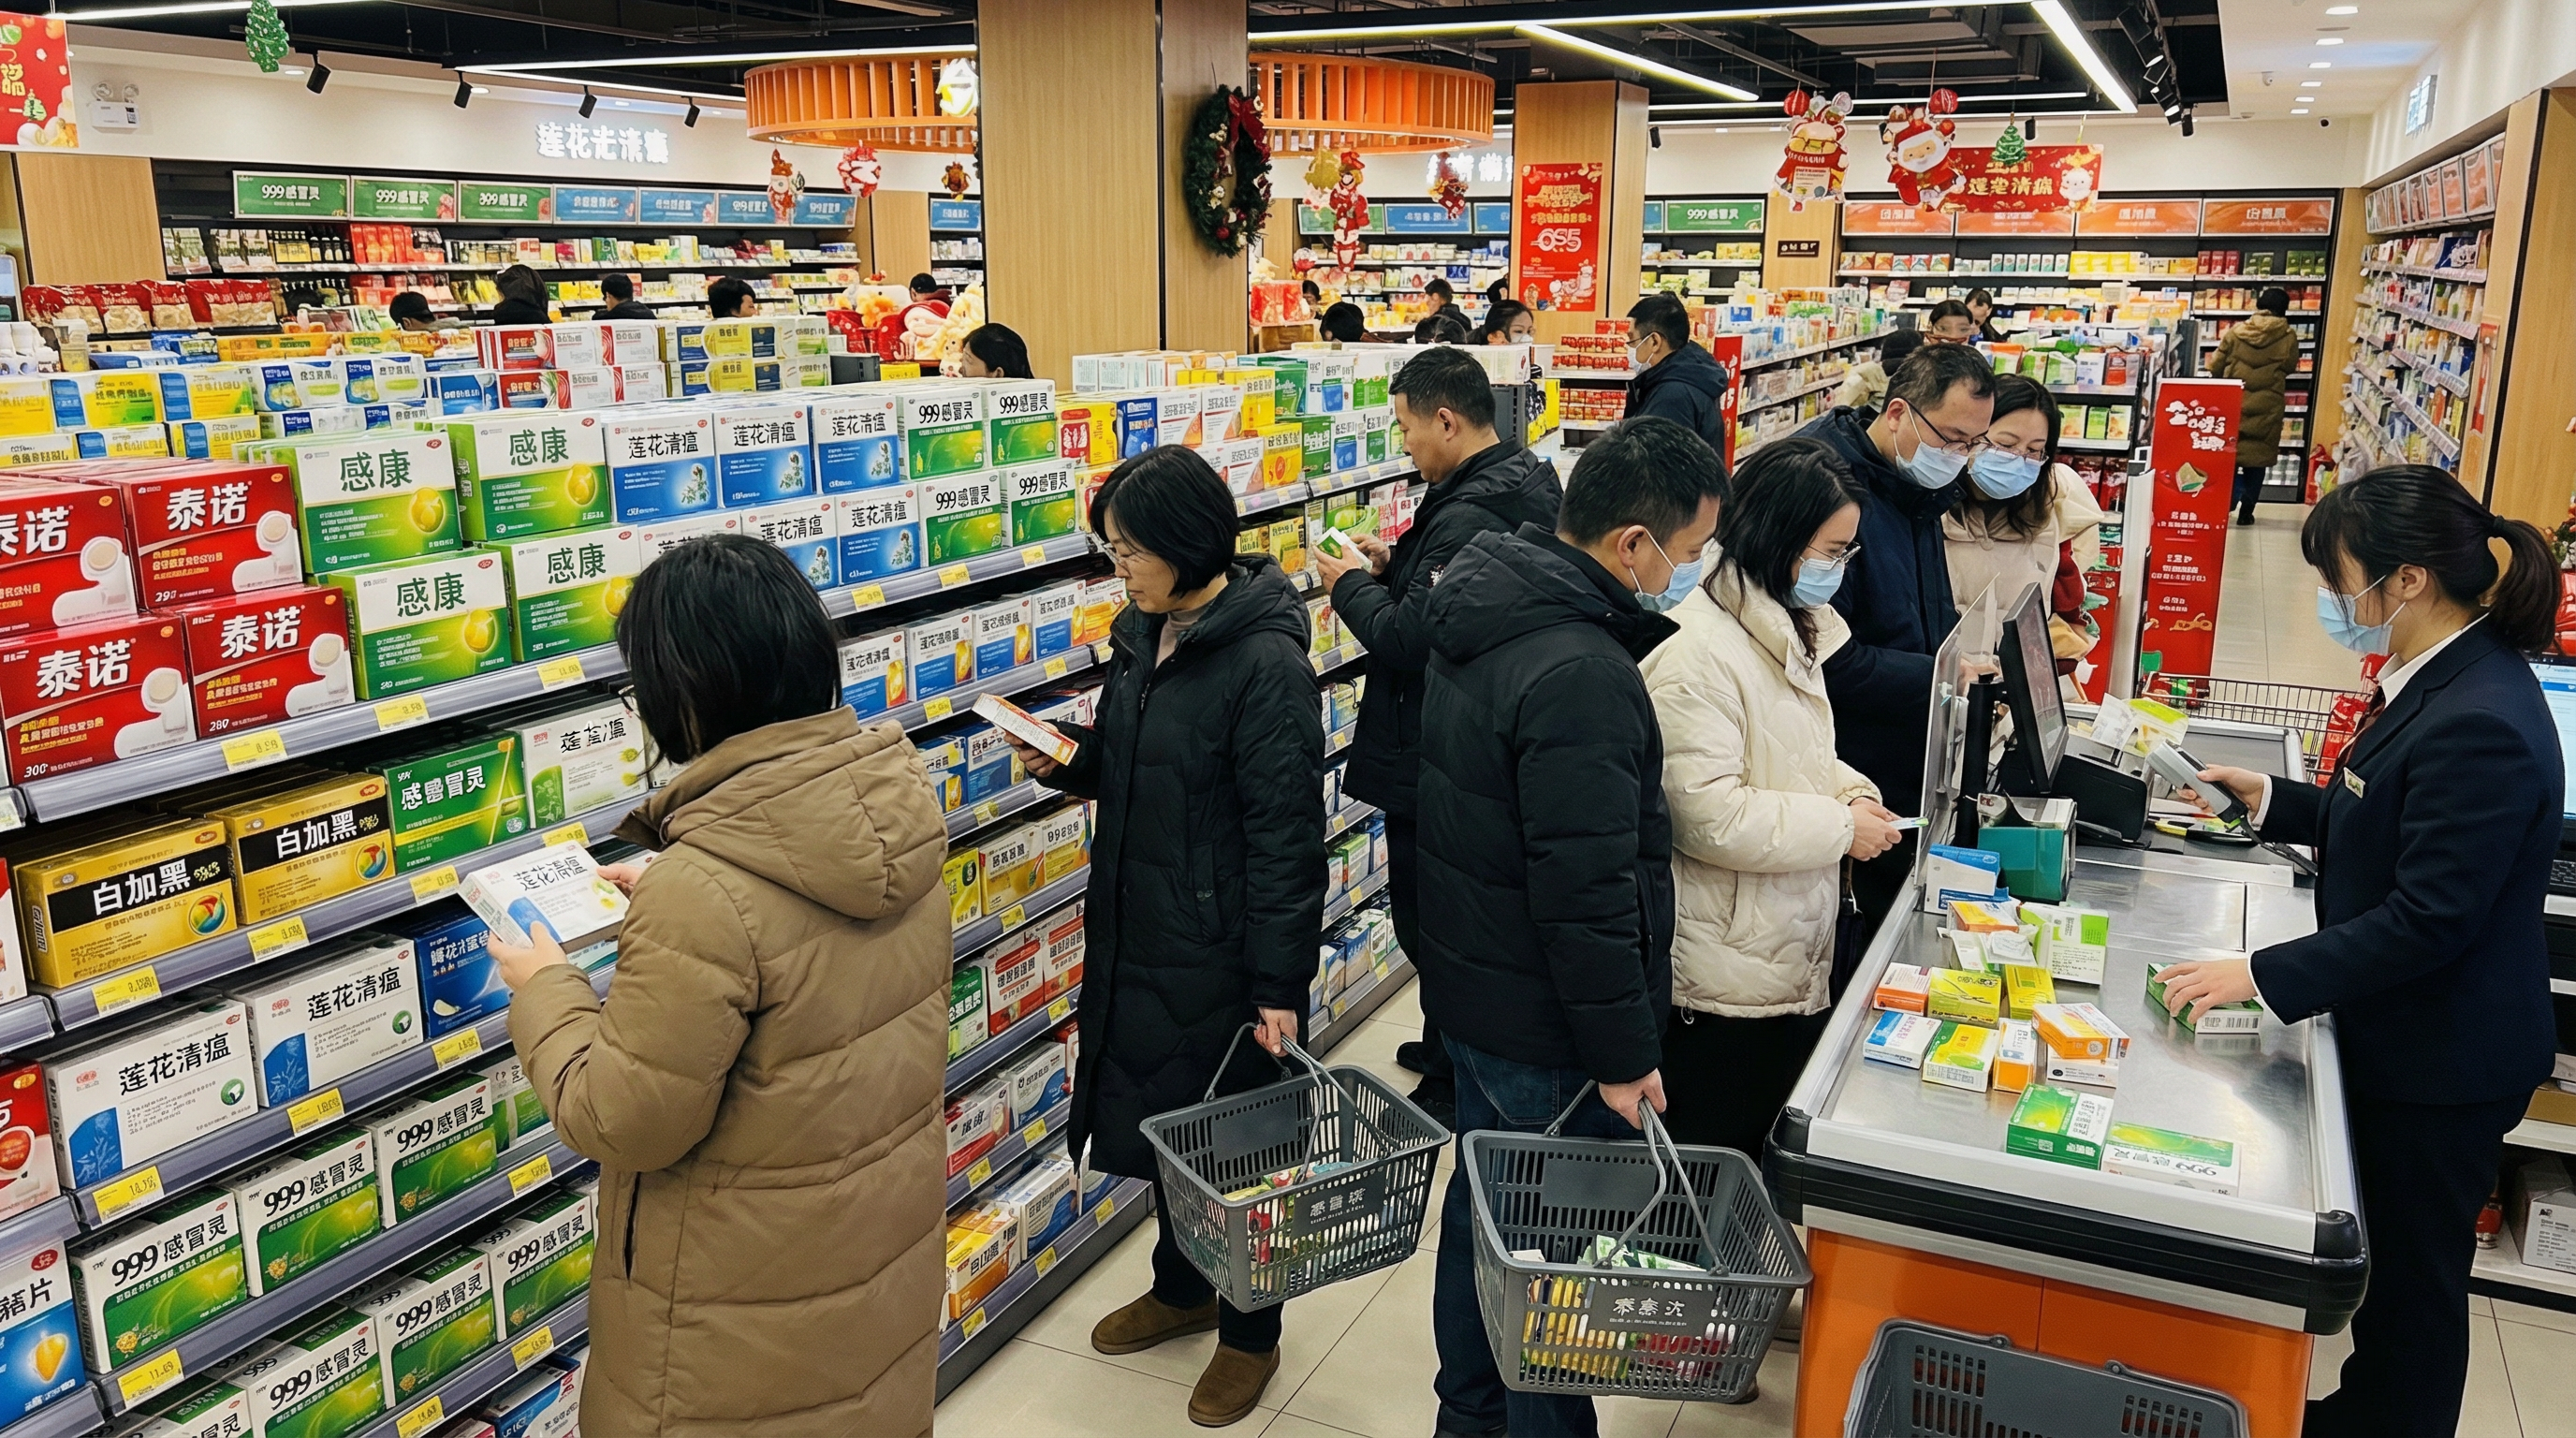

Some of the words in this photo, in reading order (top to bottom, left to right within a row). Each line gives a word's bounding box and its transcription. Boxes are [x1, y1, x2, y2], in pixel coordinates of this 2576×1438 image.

[340, 448, 413, 492] 感康
[509, 427, 569, 466] 感康
[167, 482, 248, 531] 泰诺
[548, 543, 607, 584] 感康
[397, 572, 466, 618] 感康
[221, 606, 301, 658] 泰诺
[37, 638, 131, 698] 泰诺
[276, 809, 358, 859] 白加黑
[93, 858, 191, 916] 白加黑
[307, 966, 402, 1022] 莲花清瘟
[119, 1032, 232, 1096] 莲花清瘟
